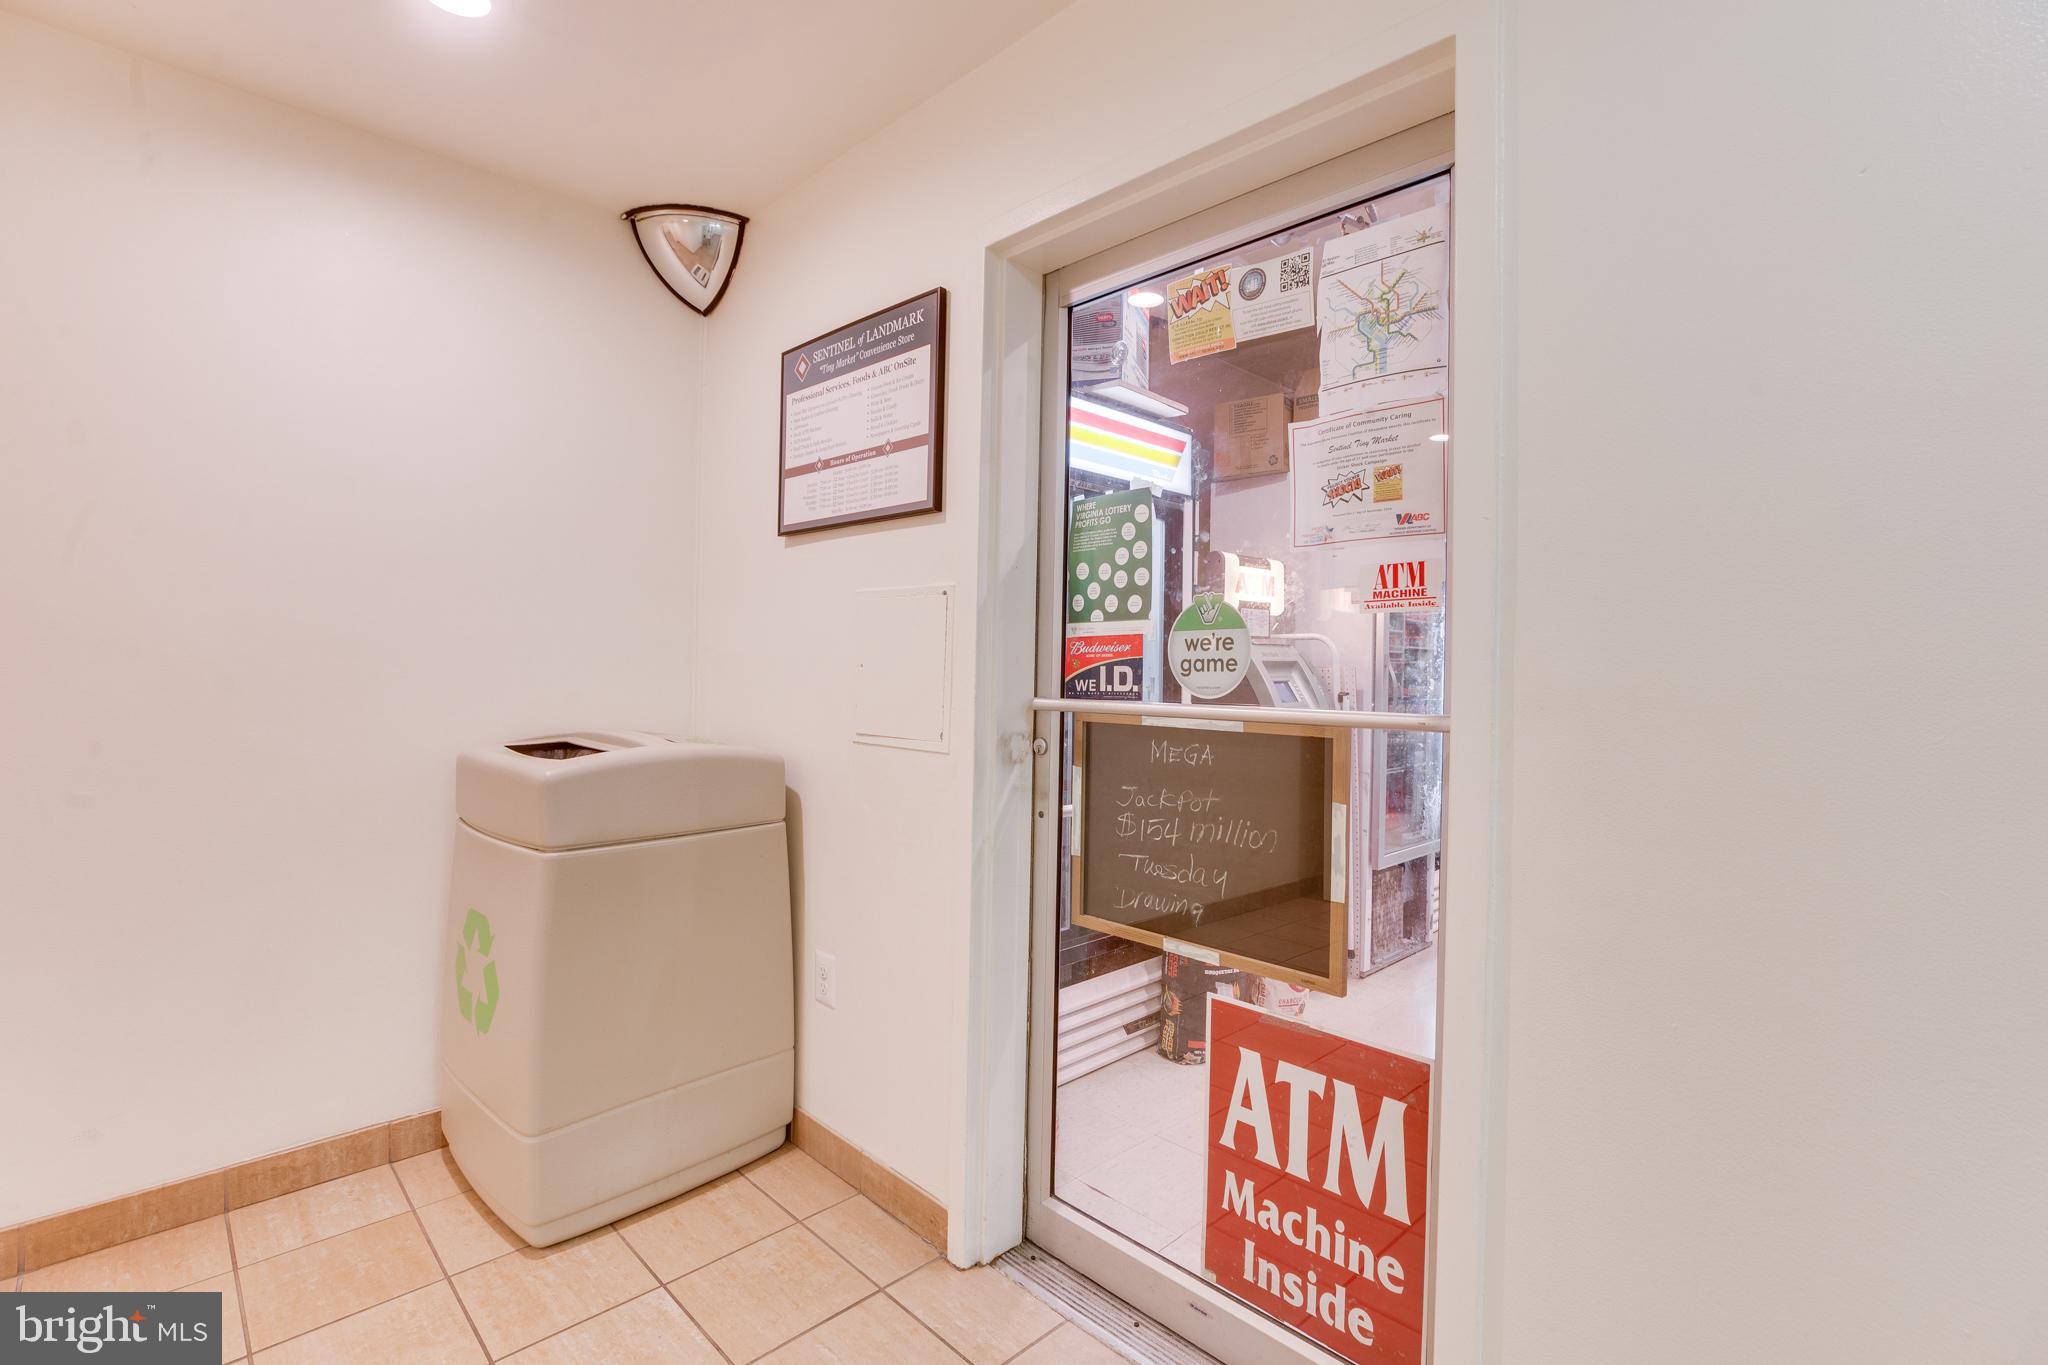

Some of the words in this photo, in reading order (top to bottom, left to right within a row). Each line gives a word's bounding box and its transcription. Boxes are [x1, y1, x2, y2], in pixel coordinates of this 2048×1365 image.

[1170, 269, 1229, 319] WAIT!
[812, 337, 856, 364] SENTINEL
[857, 334, 865, 348] of
[865, 308, 925, 343] LANDMARK
[859, 341, 897, 360] Convenience
[897, 333, 915, 347] Store
[791, 386, 825, 406] Professional
[852, 372, 871, 385] Foods
[871, 370, 878, 379] &
[878, 363, 894, 376] ABC
[894, 356, 917, 370] OnSite
[1317, 425, 1345, 436] Certificate
[1352, 416, 1389, 428] Community
[1389, 412, 1412, 422] Caring
[851, 450, 877, 462] Operation
[1328, 442, 1353, 454] Sentinel
[1354, 438, 1369, 449] Tiny
[1372, 434, 1399, 445] Market
[1076, 501, 1097, 512] WHERE
[1076, 509, 1104, 520] VIRGINIA
[1105, 503, 1132, 516] LOTTERY
[1412, 512, 1430, 522] ABC
[1075, 518, 1098, 529] PROFITS
[1098, 516, 1112, 525] GO
[1372, 560, 1426, 590] ATM
[1364, 601, 1405, 610] Available
[1407, 599, 1438, 608] Inside
[1372, 587, 1428, 600] MACHINE
[1070, 640, 1132, 656] Budweiser
[1184, 632, 1235, 652] we're
[1075, 679, 1097, 692] WE
[1099, 665, 1139, 692] I.D.
[1180, 657, 1239, 677] game
[1150, 739, 1214, 767] MEGA
[1115, 811, 1183, 846] $154
[1189, 816, 1278, 854] million
[1118, 853, 1228, 899] Tuesday
[1113, 886, 1205, 928] Drawing
[1218, 1046, 1412, 1226] ATM
[1221, 1169, 1405, 1295] Machine
[1243, 1237, 1375, 1347] Inside
